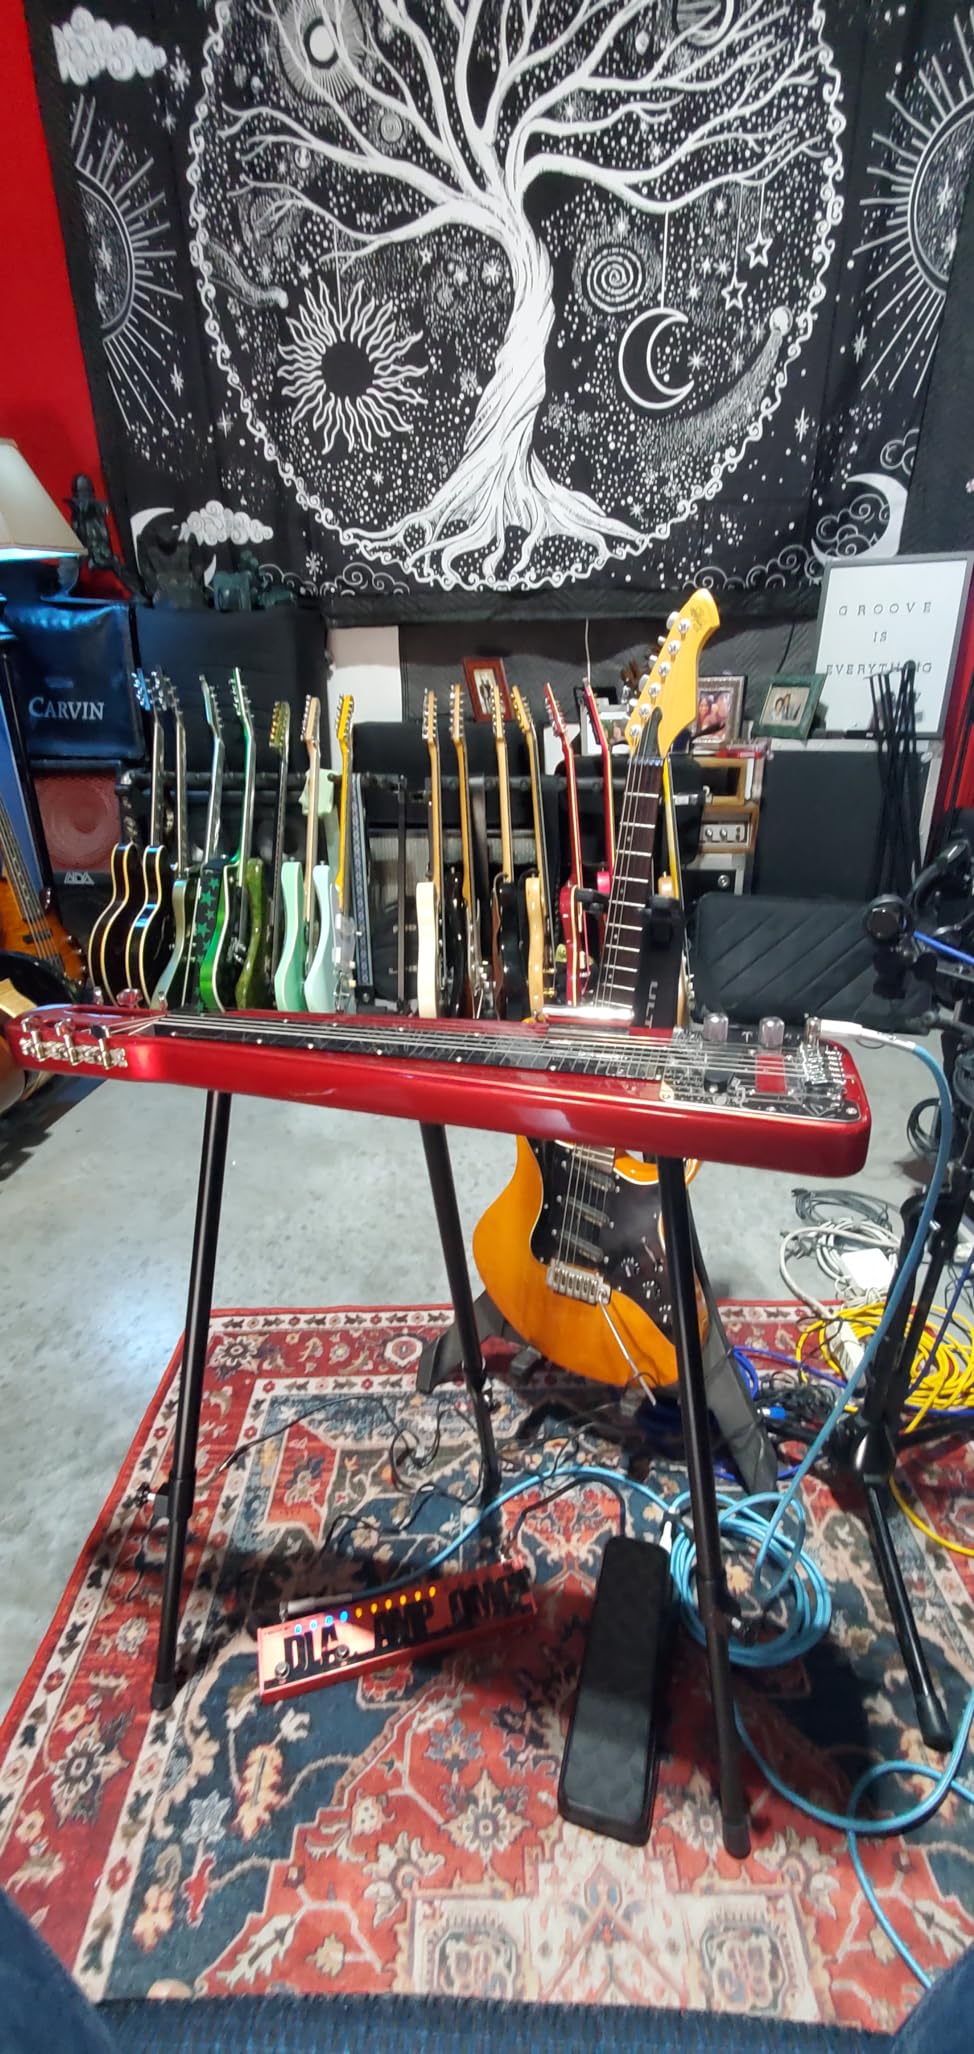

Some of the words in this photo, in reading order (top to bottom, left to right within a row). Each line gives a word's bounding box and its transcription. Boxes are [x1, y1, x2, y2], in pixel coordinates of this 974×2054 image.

[838, 601, 932, 617] GROOVE
[872, 631, 888, 643] IS
[826, 661, 933, 675] EVERYTHG
[28, 696, 105, 720] CARVIN
